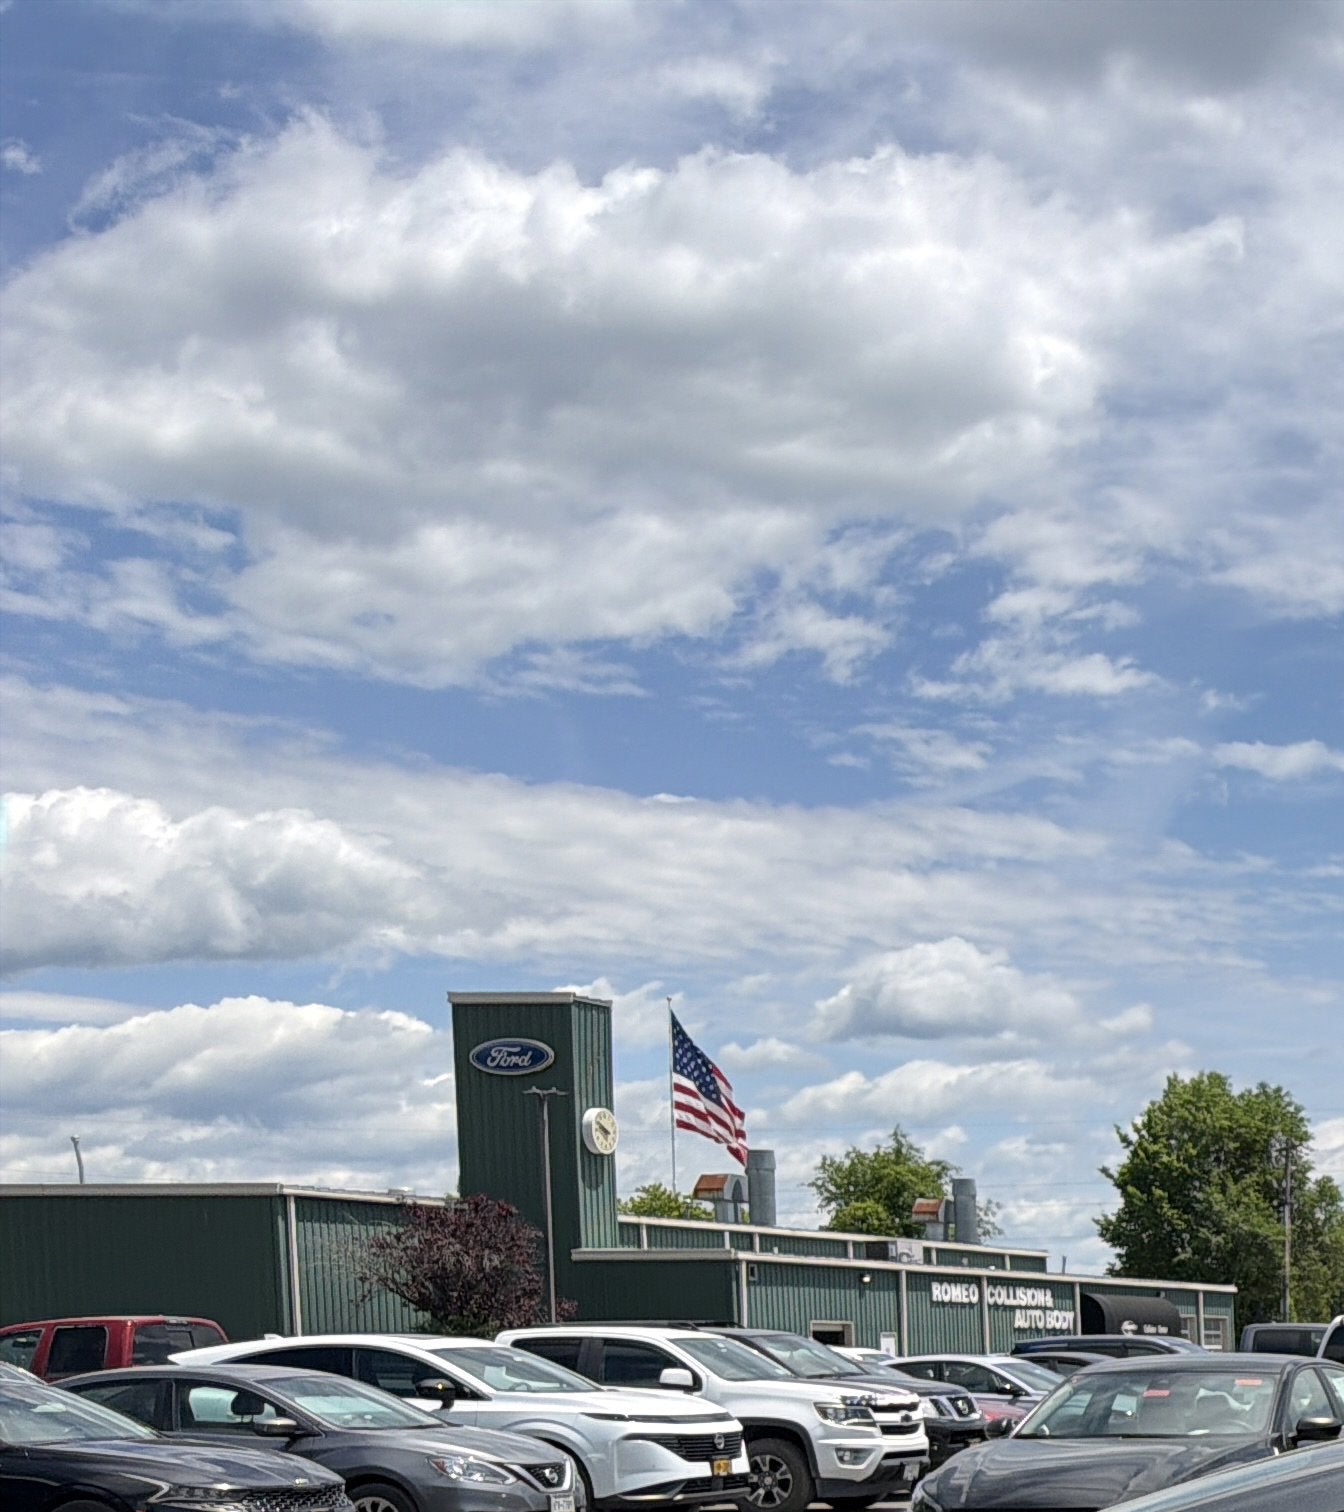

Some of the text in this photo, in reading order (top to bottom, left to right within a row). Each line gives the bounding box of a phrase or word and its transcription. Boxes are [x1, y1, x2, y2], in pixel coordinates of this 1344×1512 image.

[486, 1046, 533, 1067] Ford
[931, 1282, 979, 1303] ROMEO
[987, 1285, 1044, 1307] COLLISION
[1014, 1309, 1074, 1331] AUTO BODY
